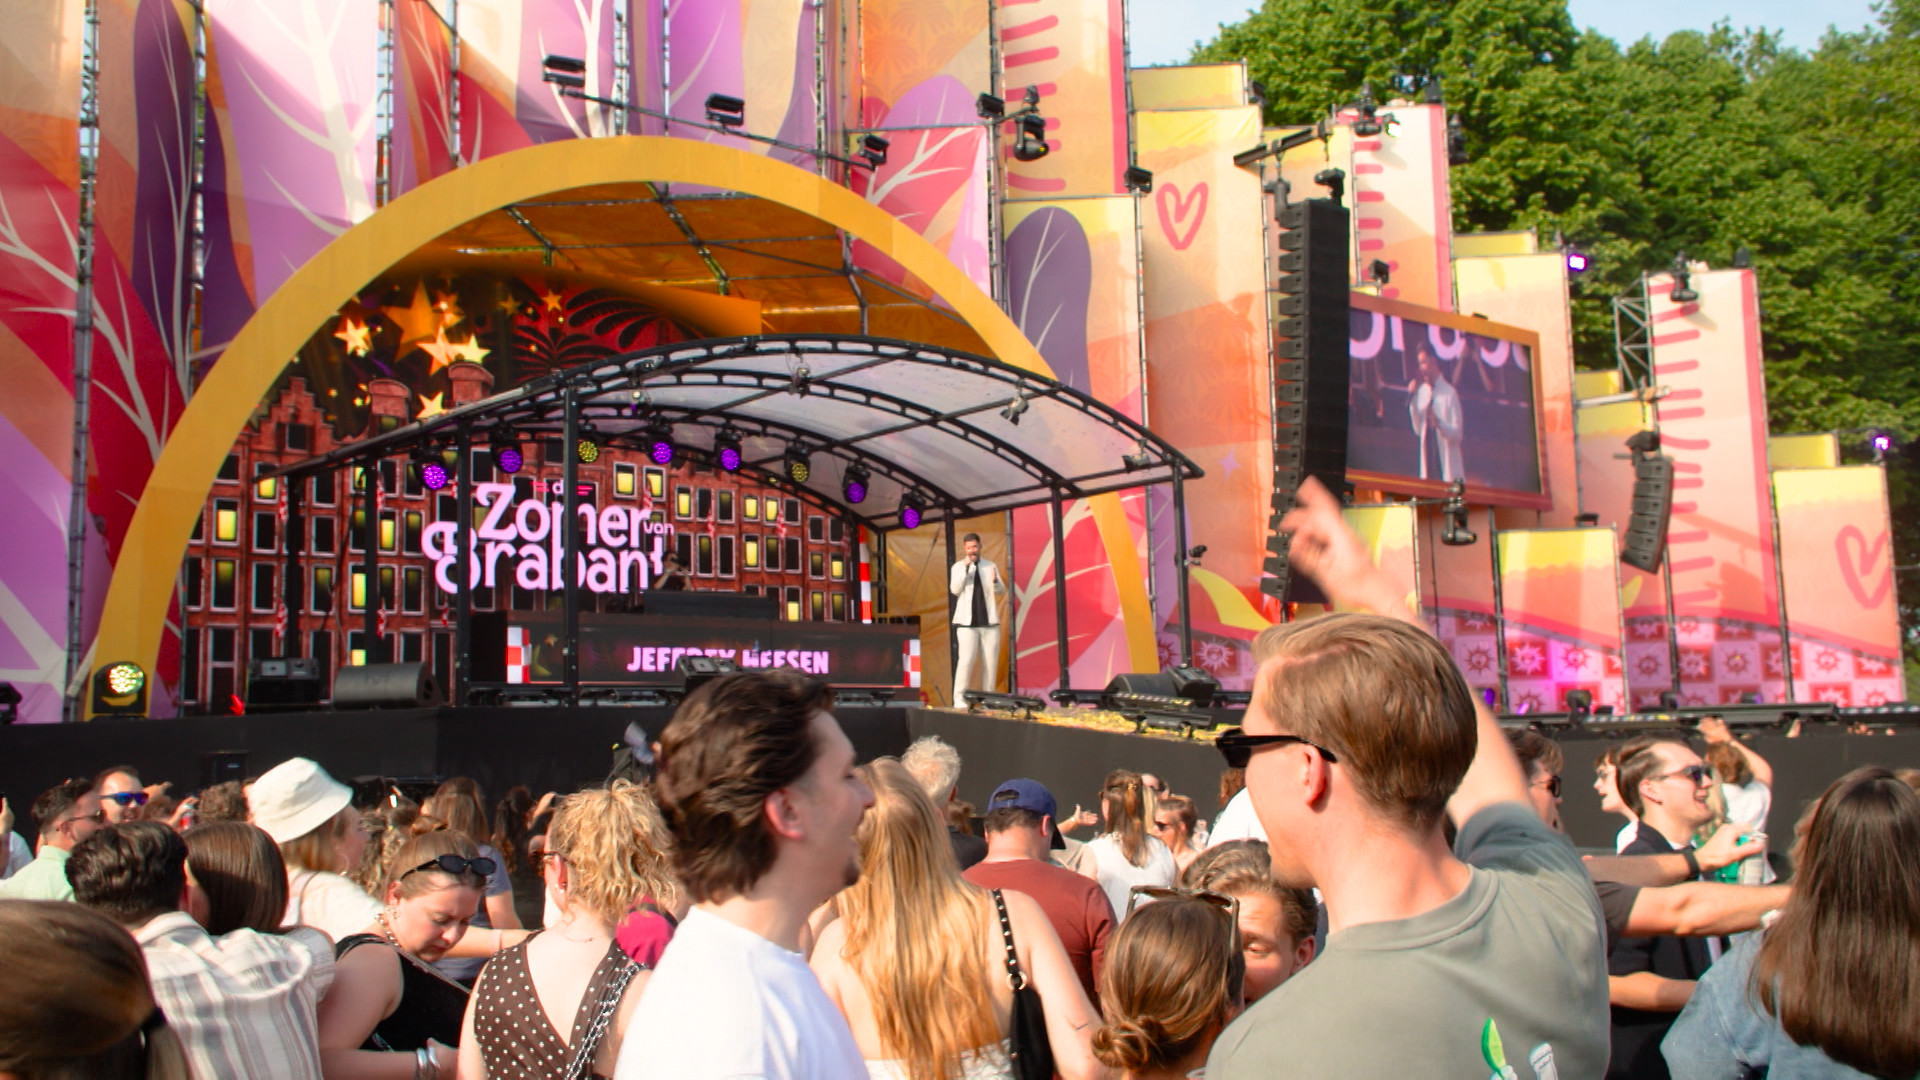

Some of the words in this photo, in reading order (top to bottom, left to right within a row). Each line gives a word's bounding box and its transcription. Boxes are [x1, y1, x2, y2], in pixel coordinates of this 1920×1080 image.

[474, 482, 652, 548] Zomer
[643, 521, 674, 536] van
[421, 521, 663, 594] Brabant
